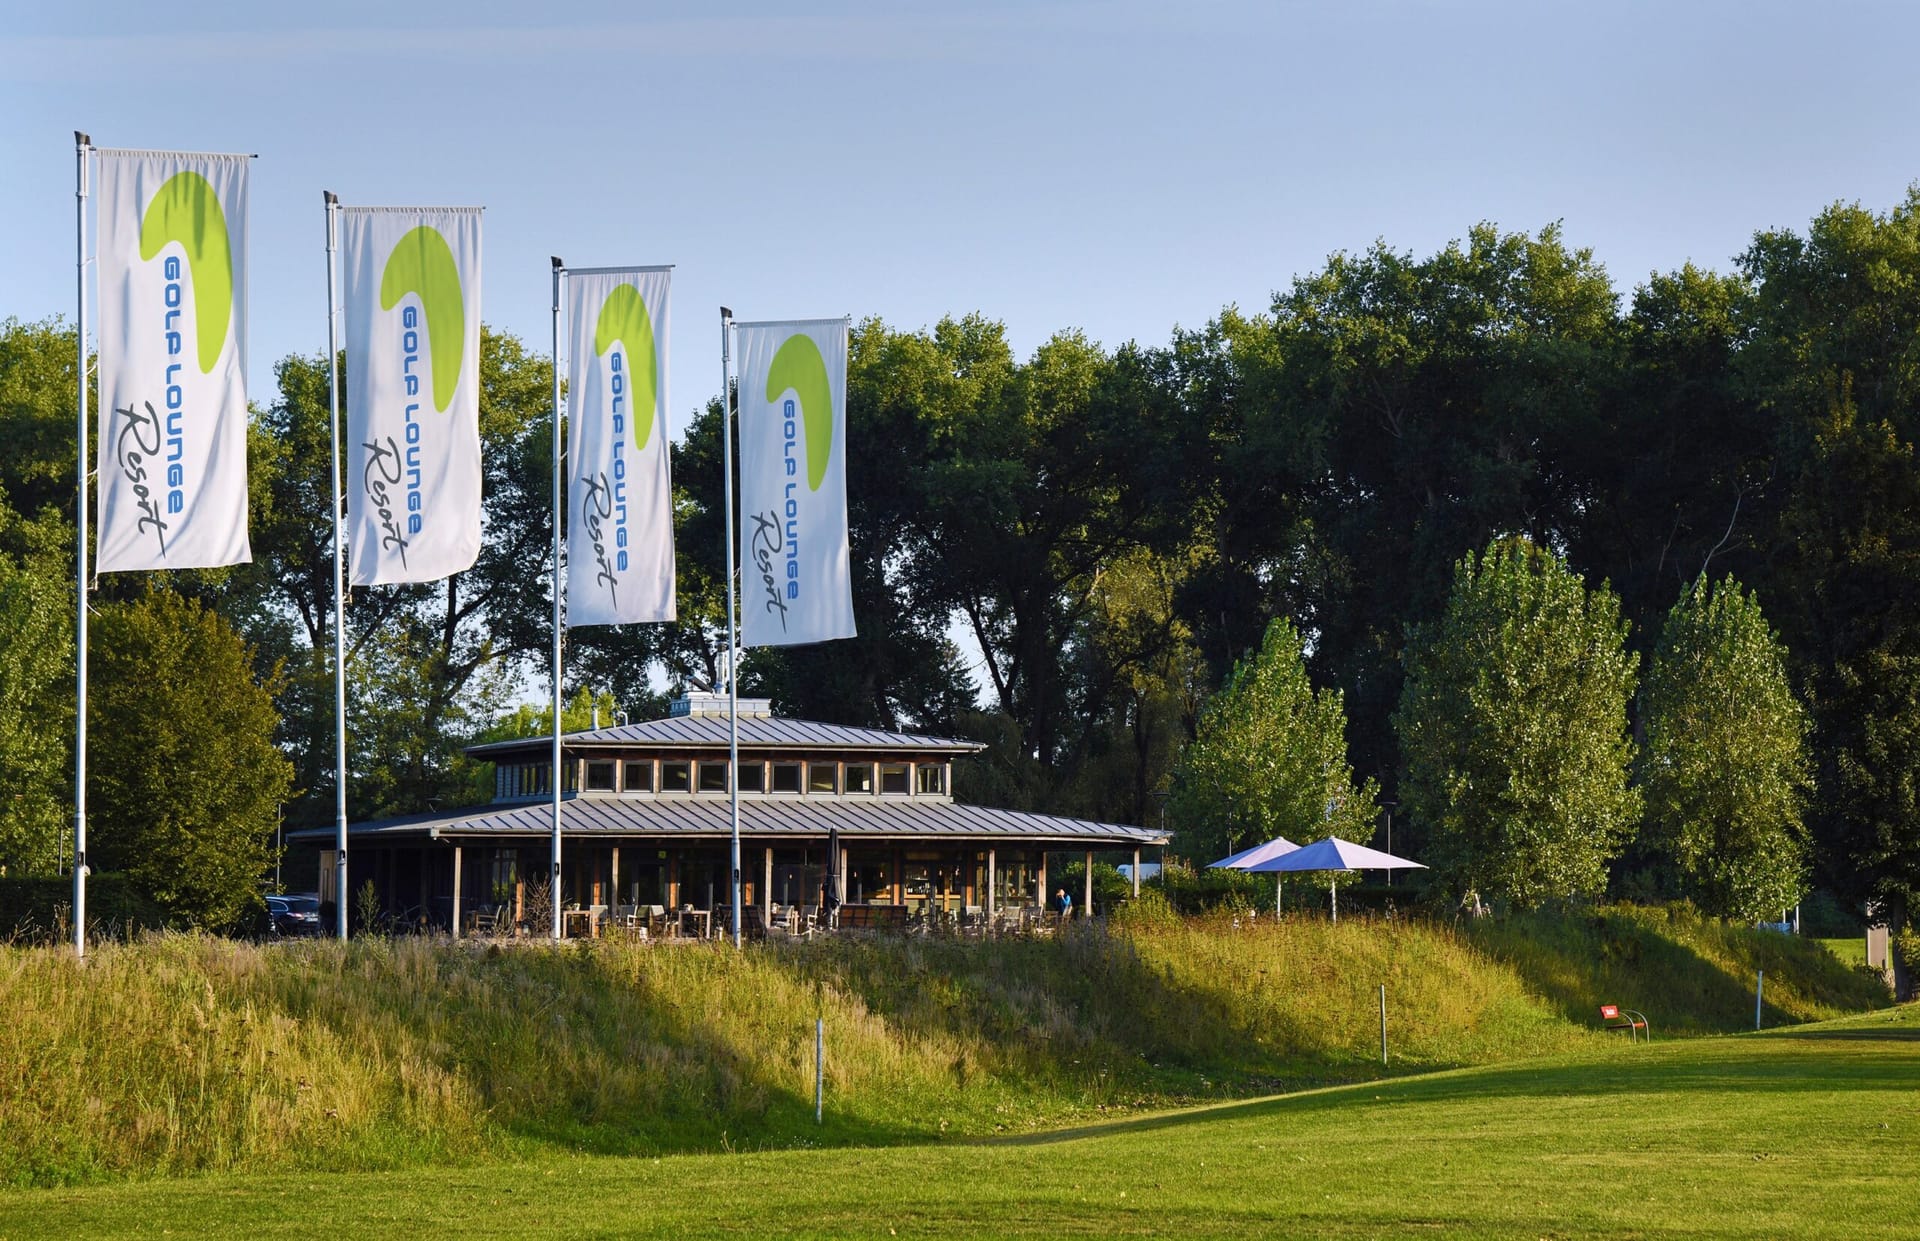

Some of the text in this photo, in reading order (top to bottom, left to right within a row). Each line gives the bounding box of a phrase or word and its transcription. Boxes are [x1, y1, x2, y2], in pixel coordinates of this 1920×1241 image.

[164, 256, 181, 354] GOLF
[402, 306, 418, 396] GOLF
[611, 352, 624, 434] GOLF
[783, 399, 797, 476] GOLF
[116, 400, 168, 559] Resort
[363, 437, 409, 571] Resort
[582, 471, 618, 612] Resort
[750, 510, 787, 635] Resort
